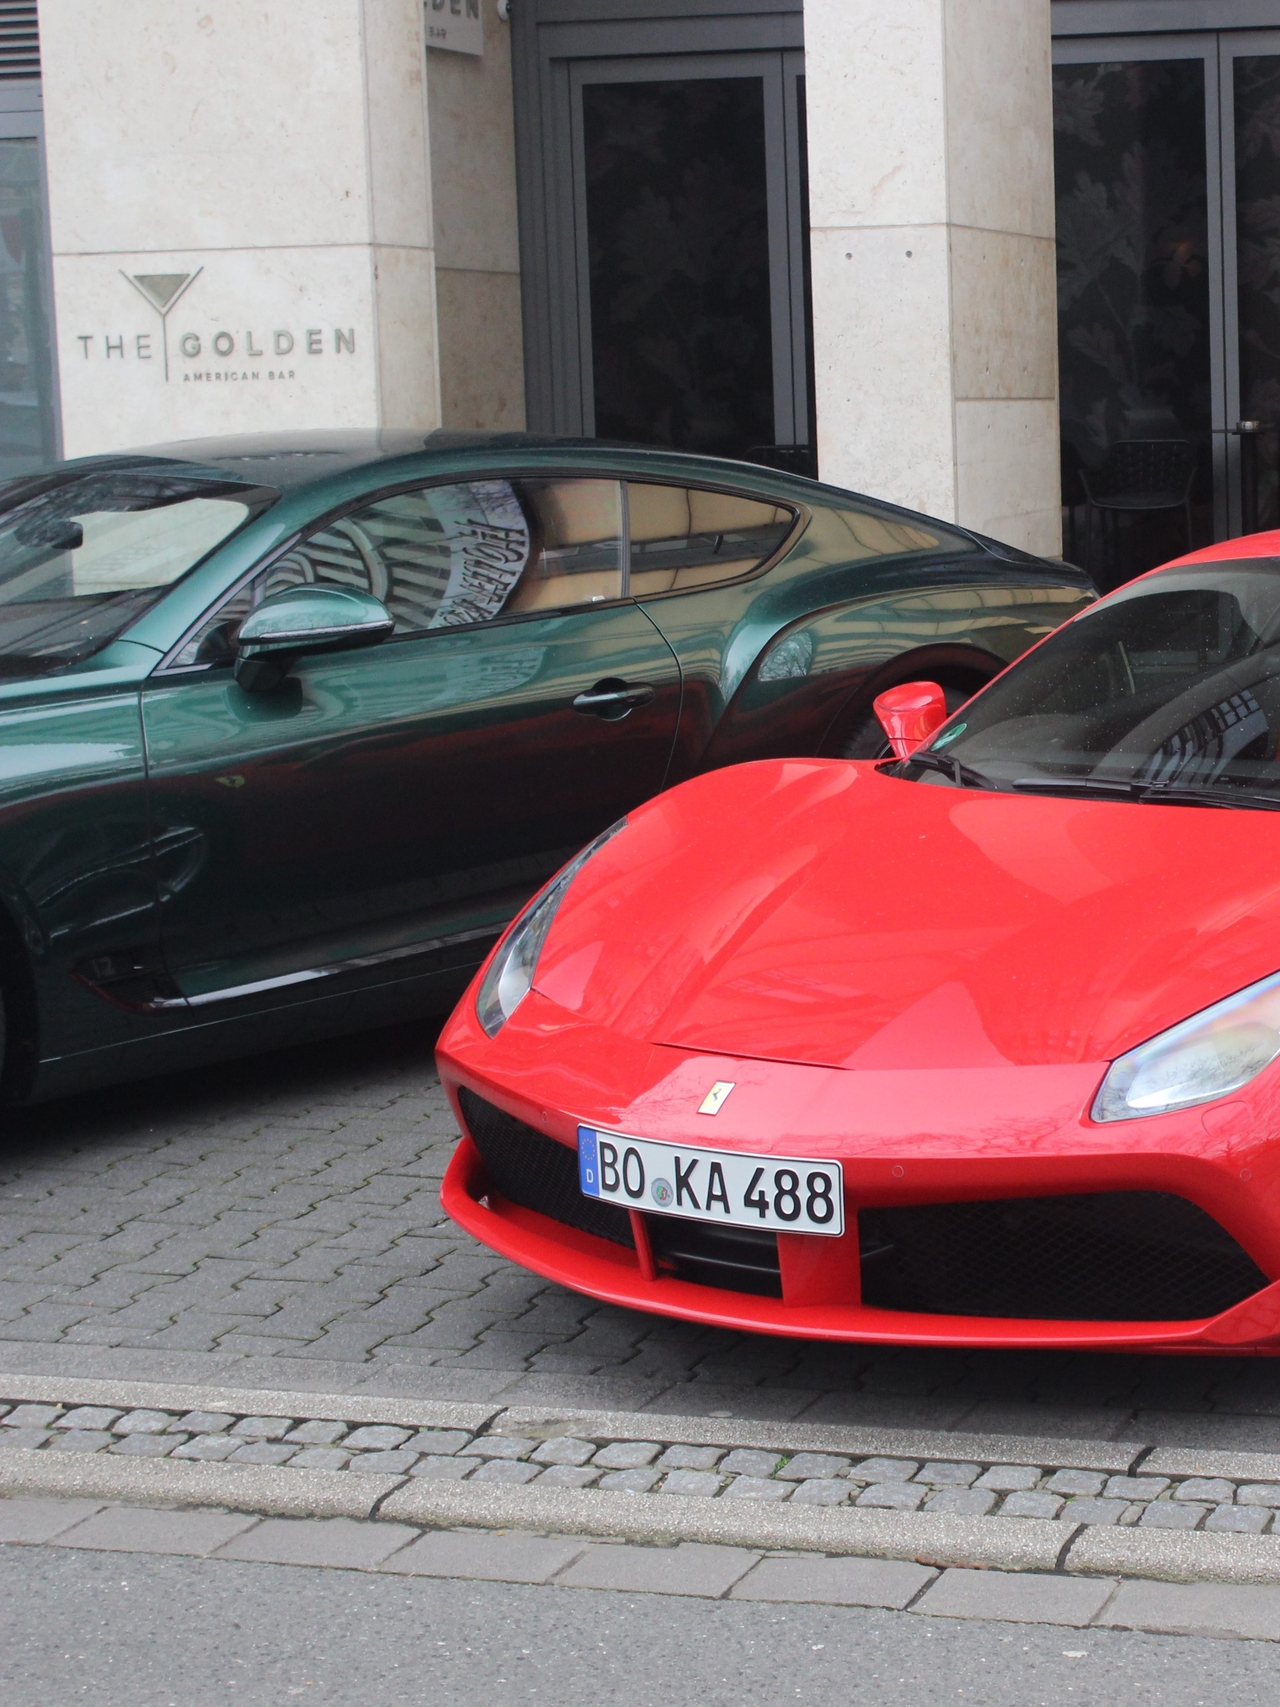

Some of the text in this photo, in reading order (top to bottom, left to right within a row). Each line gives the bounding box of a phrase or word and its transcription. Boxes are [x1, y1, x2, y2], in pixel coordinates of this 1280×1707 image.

[76, 327, 356, 360] THE GOLDEN
[183, 370, 296, 383] AMERICAN BAR
[586, 1168, 594, 1184] D
[599, 1140, 645, 1199] BO
[674, 1155, 731, 1214] KA
[743, 1166, 835, 1224] 488
